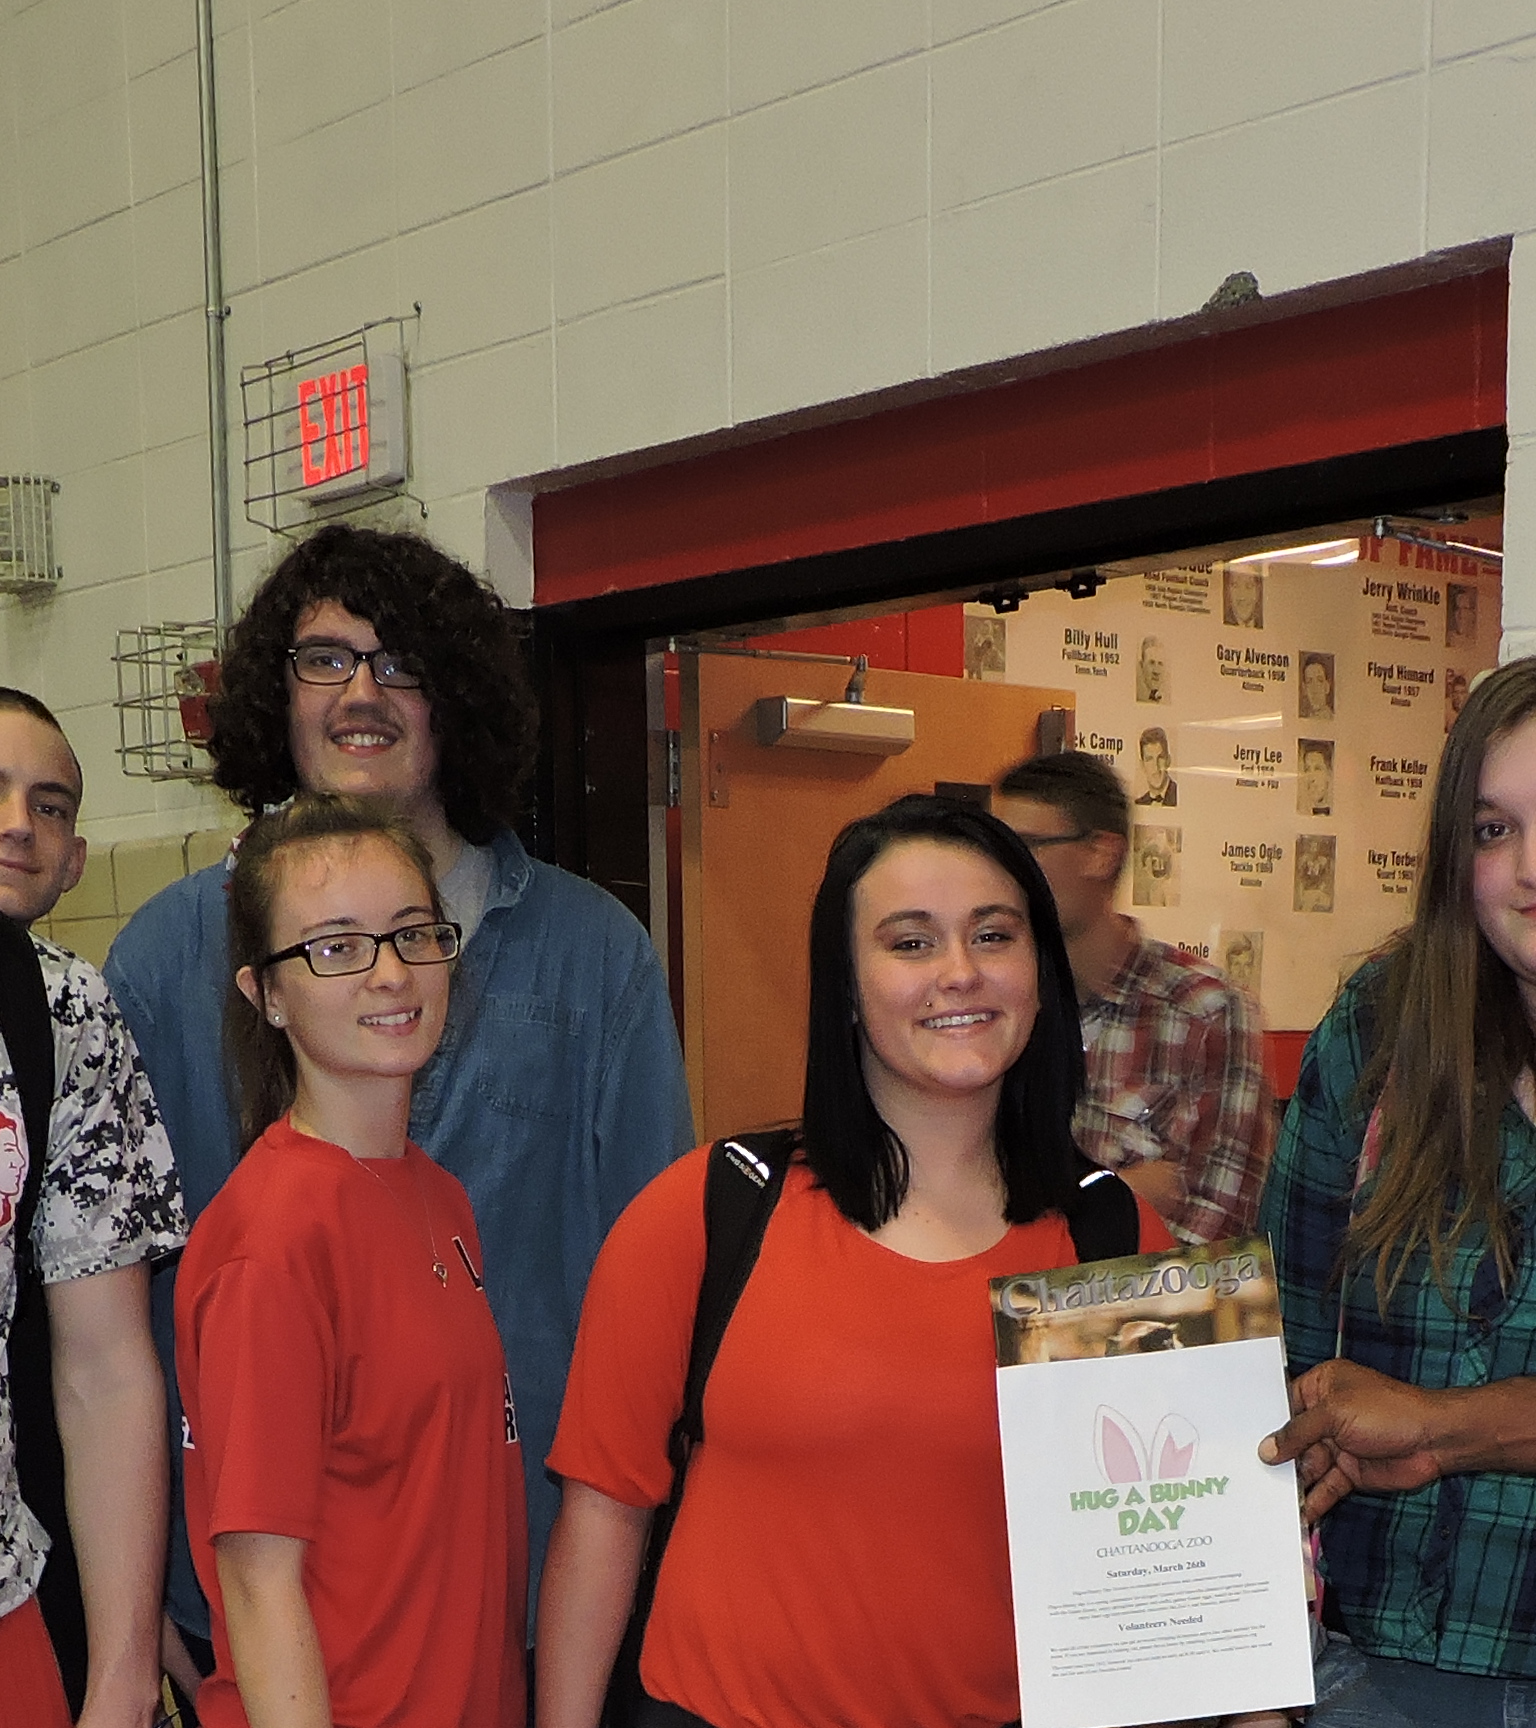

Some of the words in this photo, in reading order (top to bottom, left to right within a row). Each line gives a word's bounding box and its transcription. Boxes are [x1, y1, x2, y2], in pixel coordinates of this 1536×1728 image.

[298, 363, 369, 486] EXIT
[1363, 577, 1393, 604] Jerry
[1397, 581, 1440, 605] Wrinkle
[1064, 628, 1091, 650] Billy
[1094, 631, 1118, 650] Hull
[1216, 643, 1241, 666] Gary
[1244, 647, 1290, 667] Alverson
[1367, 661, 1394, 684] Floyd
[1089, 732, 1123, 755] Camp
[1233, 743, 1261, 765] Jerry
[1263, 746, 1283, 764] Lee
[1370, 755, 1398, 773] Frank
[1221, 841, 1257, 859] James
[1000, 1251, 1264, 1320] Chattazooga
[1069, 1487, 1120, 1512] HUG
[1124, 1485, 1147, 1506] A
[1149, 1475, 1231, 1504] BUNNY
[1117, 1503, 1187, 1536] DAY
[1095, 1537, 1185, 1559] CHATTANOOGA
[1185, 1535, 1214, 1549] ZOO
[1105, 1567, 1152, 1580] Saturday,
[1153, 1562, 1184, 1574] March
[1186, 1559, 1207, 1571] 26th
[1117, 1620, 1167, 1632] Volunteers
[1169, 1614, 1204, 1627] Needed
